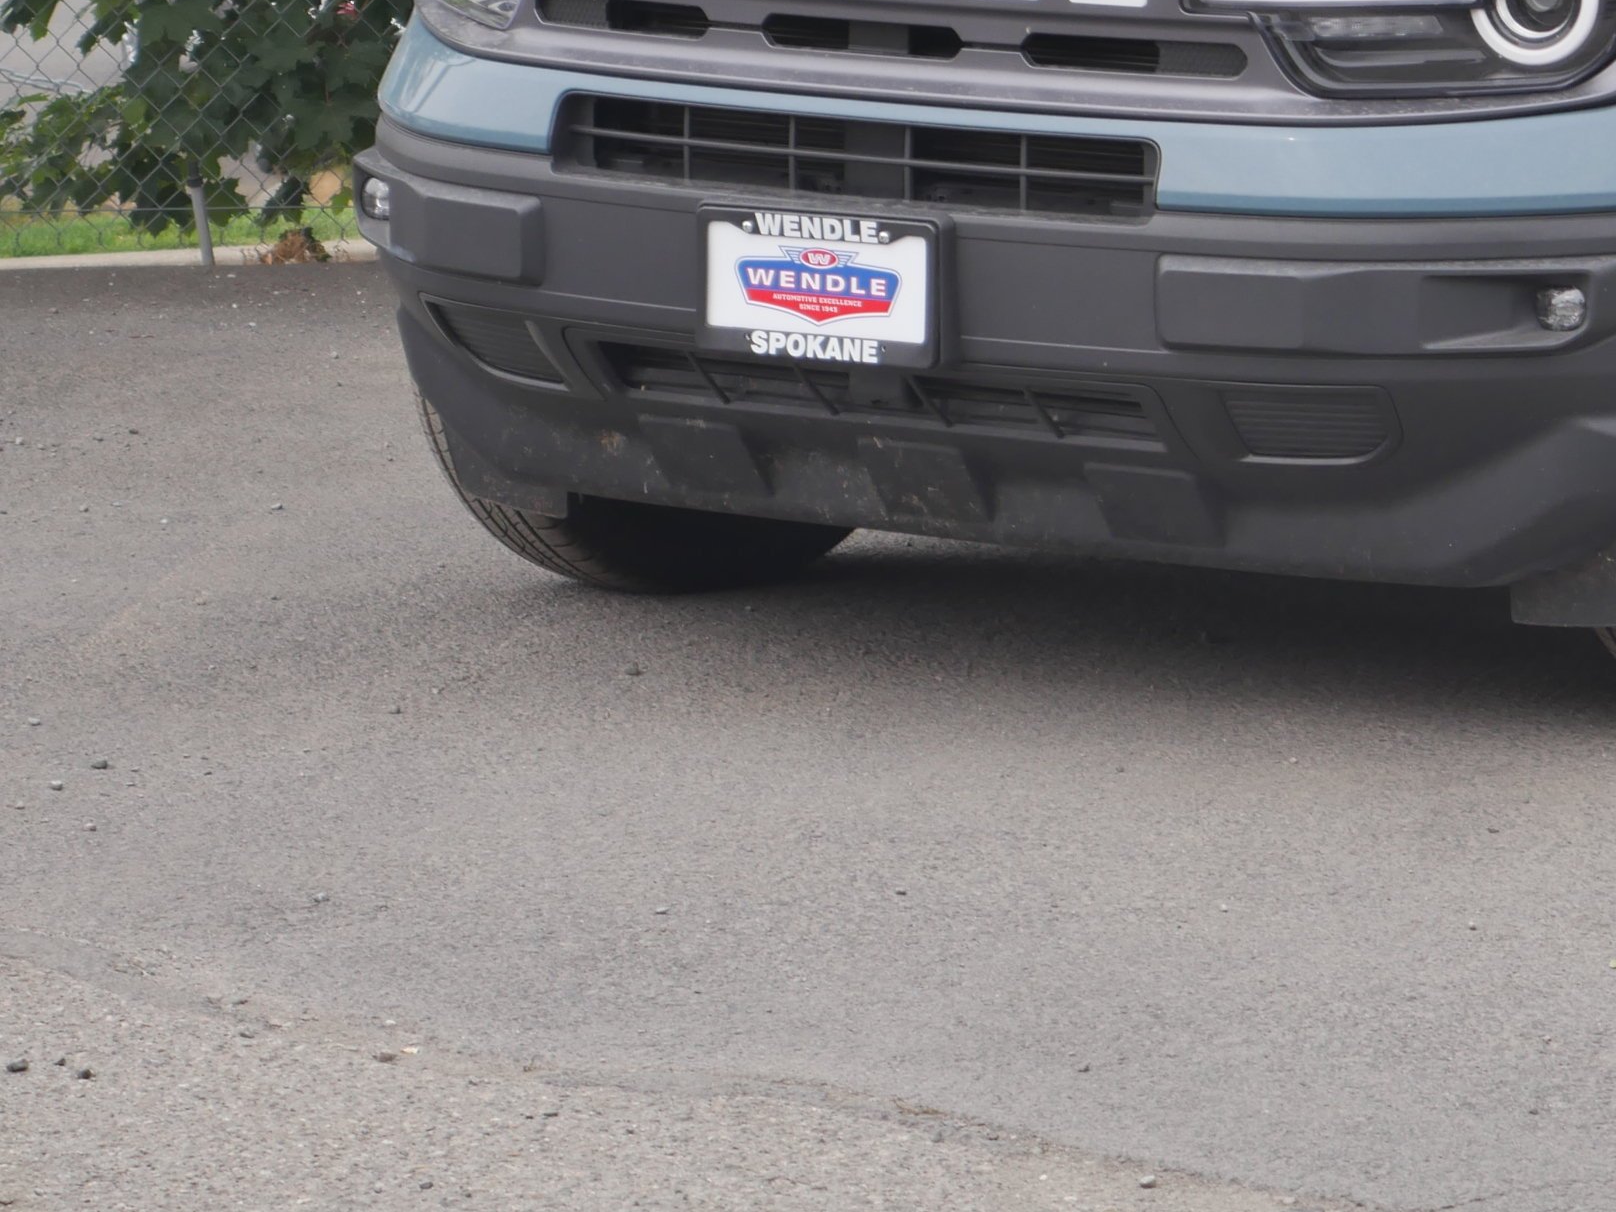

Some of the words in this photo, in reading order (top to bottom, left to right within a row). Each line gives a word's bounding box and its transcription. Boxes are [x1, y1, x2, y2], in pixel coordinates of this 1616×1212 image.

[755, 212, 879, 243] WENDLE
[807, 251, 831, 265] W
[747, 268, 886, 296] WENDLE
[772, 292, 817, 303] AUTOMOTIVE
[819, 297, 862, 308] EXCELLENCE
[799, 303, 820, 312] SINCE
[751, 330, 878, 364] SPOKANE
